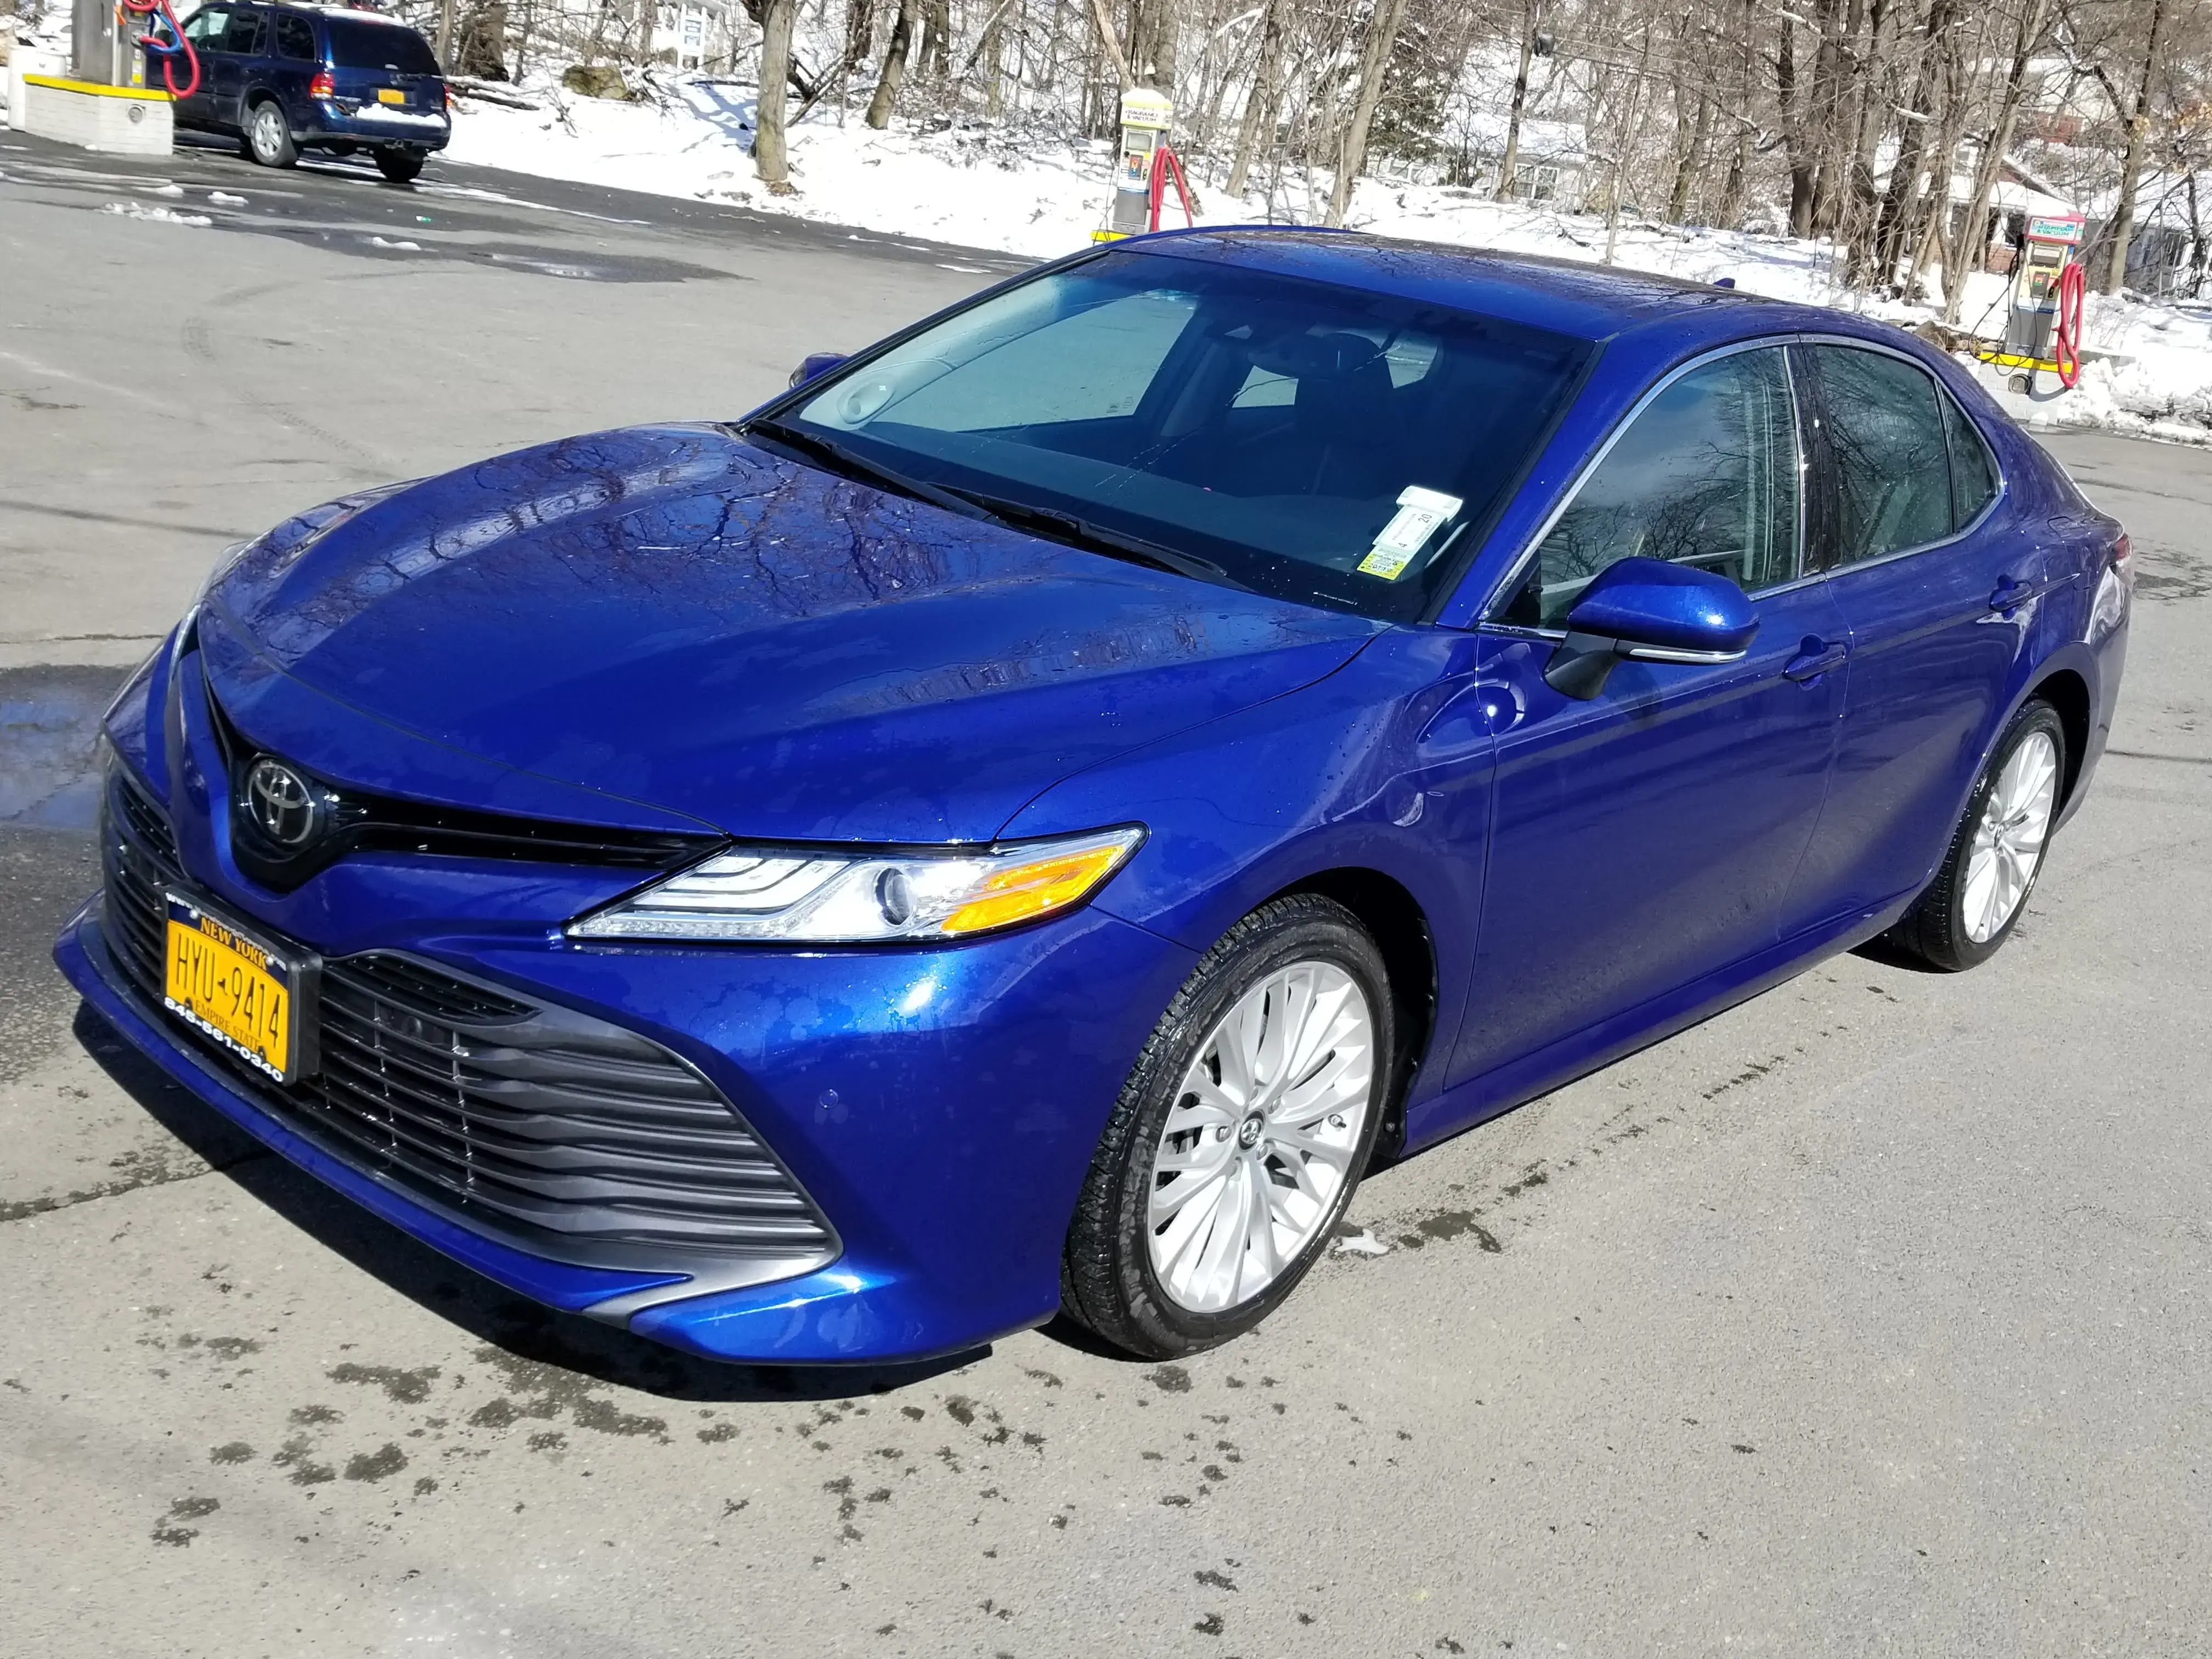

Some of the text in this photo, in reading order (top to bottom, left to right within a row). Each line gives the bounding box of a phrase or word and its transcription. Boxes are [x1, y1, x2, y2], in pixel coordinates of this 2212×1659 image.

[200, 917, 268, 971] NEW YORK
[164, 996, 284, 1082] 845-561-0340
[195, 999, 261, 1052] EMPIRE STATE
